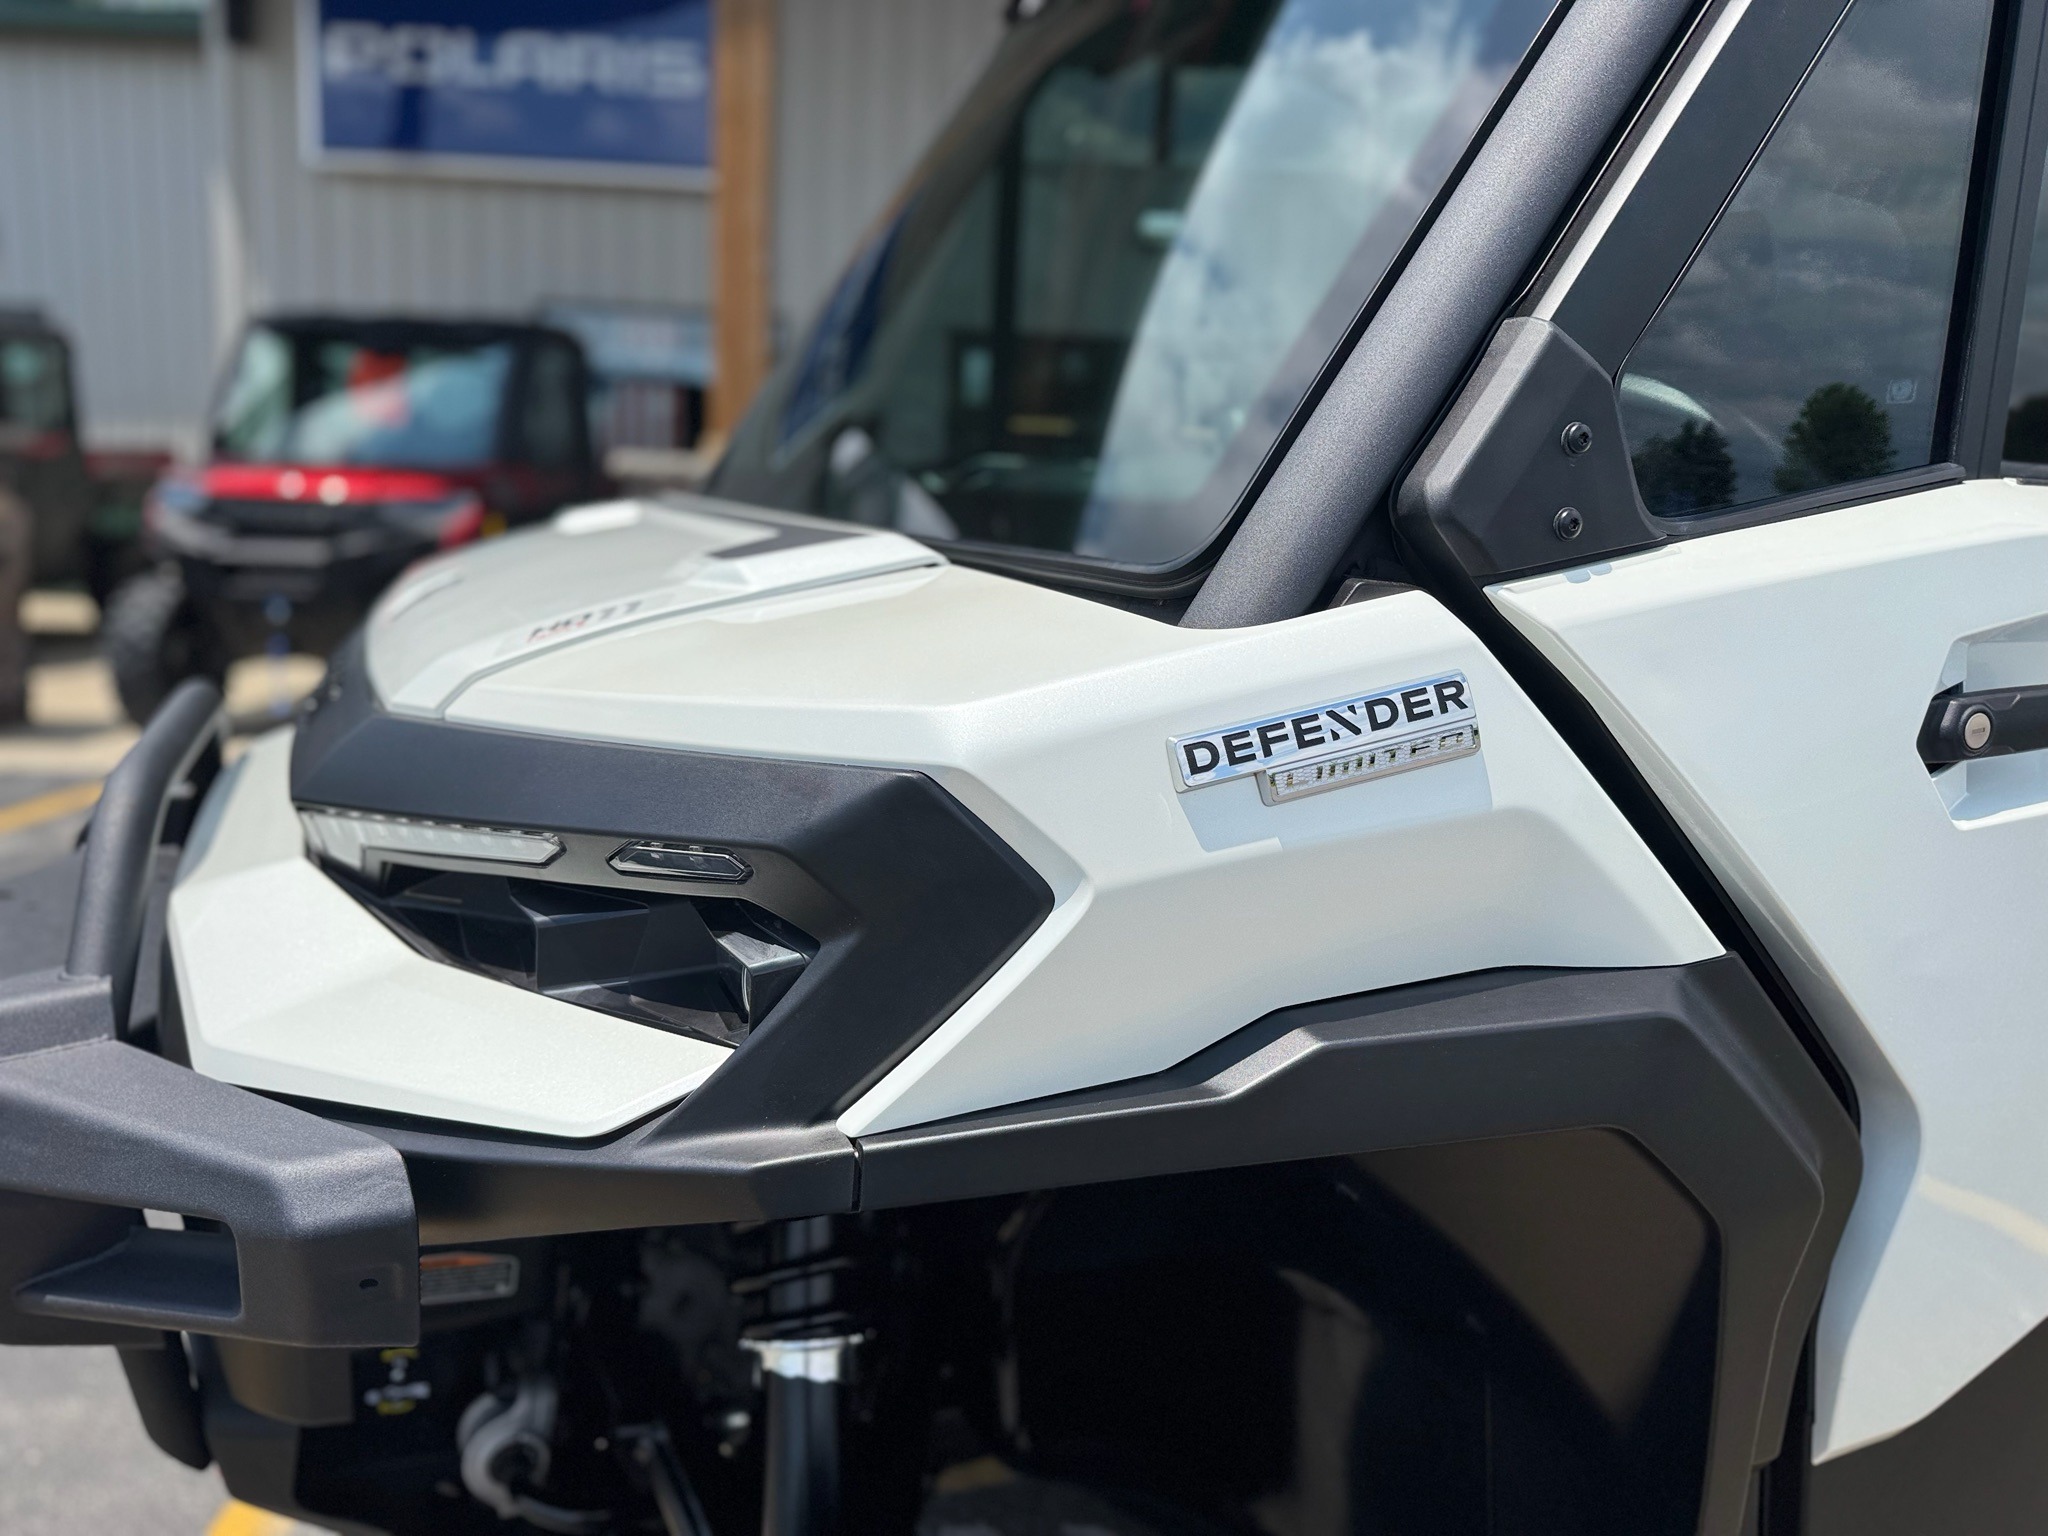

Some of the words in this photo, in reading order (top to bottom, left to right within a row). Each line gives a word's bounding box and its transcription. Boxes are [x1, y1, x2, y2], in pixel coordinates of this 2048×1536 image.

[323, 21, 707, 98] POLARIS
[1182, 679, 1469, 776] DEFENDER
[1284, 731, 1465, 788] LIMITED
